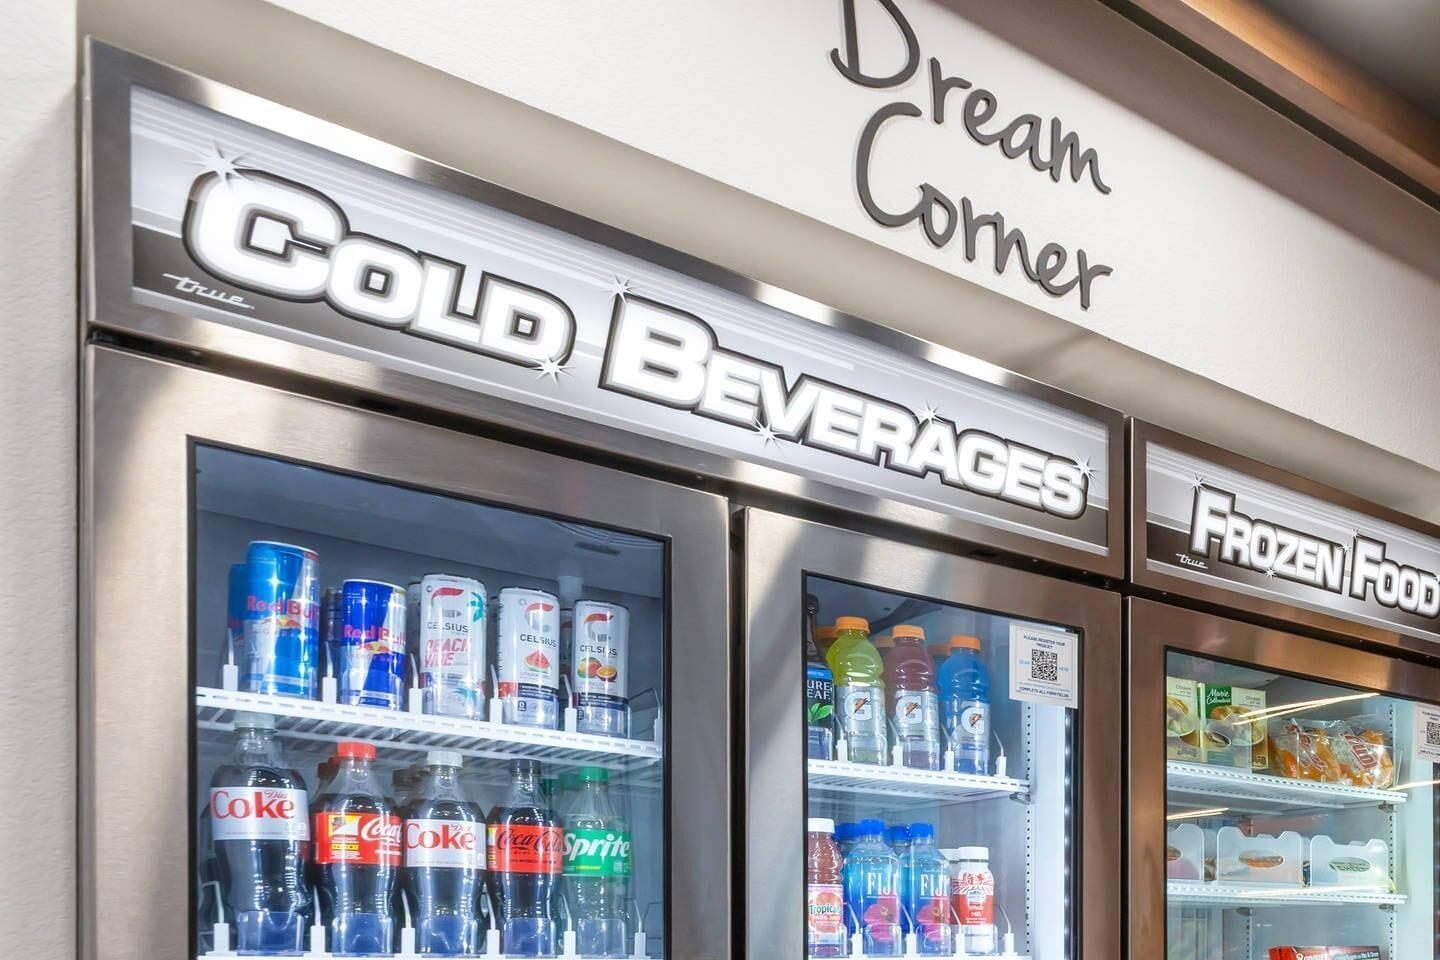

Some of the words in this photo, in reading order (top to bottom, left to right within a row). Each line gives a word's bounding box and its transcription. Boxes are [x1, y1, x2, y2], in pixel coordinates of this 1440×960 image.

[830, 0, 1112, 194] Dream
[856, 101, 1114, 310] Corner
[182, 169, 577, 367] COLD
[598, 294, 1089, 519] BEVERAGES
[1190, 484, 1344, 593] FROZEN
[247, 596, 283, 613] Red
[343, 625, 375, 639] Red
[427, 622, 469, 634] CELSIUS
[520, 633, 560, 648] CELSIUS
[579, 644, 618, 657] CELSIUS
[807, 680, 831, 692] URE
[807, 689, 829, 700] EAF
[210, 790, 295, 820] Coke
[405, 822, 476, 851] Coke
[562, 833, 630, 861] Sprite
[867, 871, 898, 896] FIJI
[920, 874, 948, 896] FIJI
